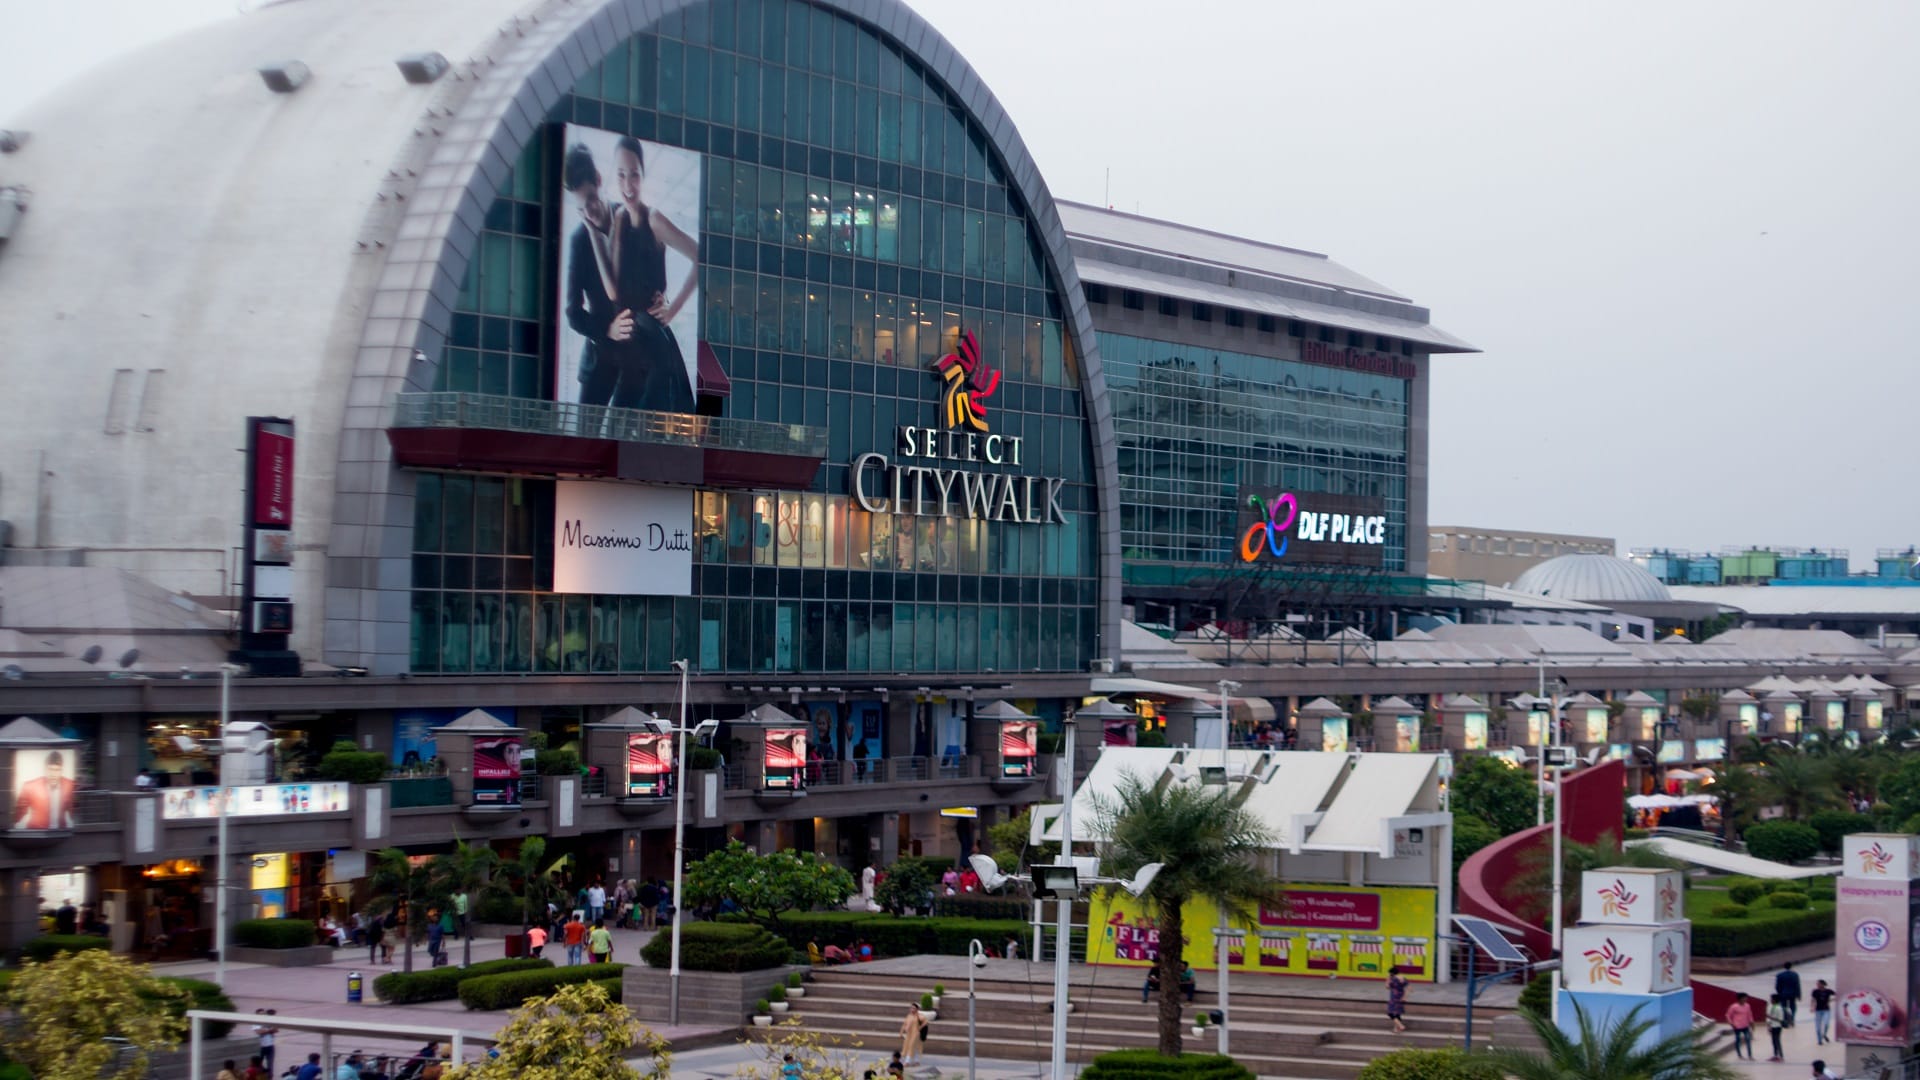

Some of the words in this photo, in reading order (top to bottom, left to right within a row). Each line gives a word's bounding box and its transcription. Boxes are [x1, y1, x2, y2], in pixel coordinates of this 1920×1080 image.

[1305, 340, 1345, 366] Hilton
[1348, 348, 1393, 375] Garden
[1396, 358, 1417, 378] Inn
[904, 425, 1022, 466] SELECT
[854, 452, 1070, 525] CITYWALK
[562, 519, 641, 549] Massimo
[646, 522, 692, 552] Dutti
[1298, 511, 1330, 542] DLF
[1331, 513, 1386, 545] PLACE
